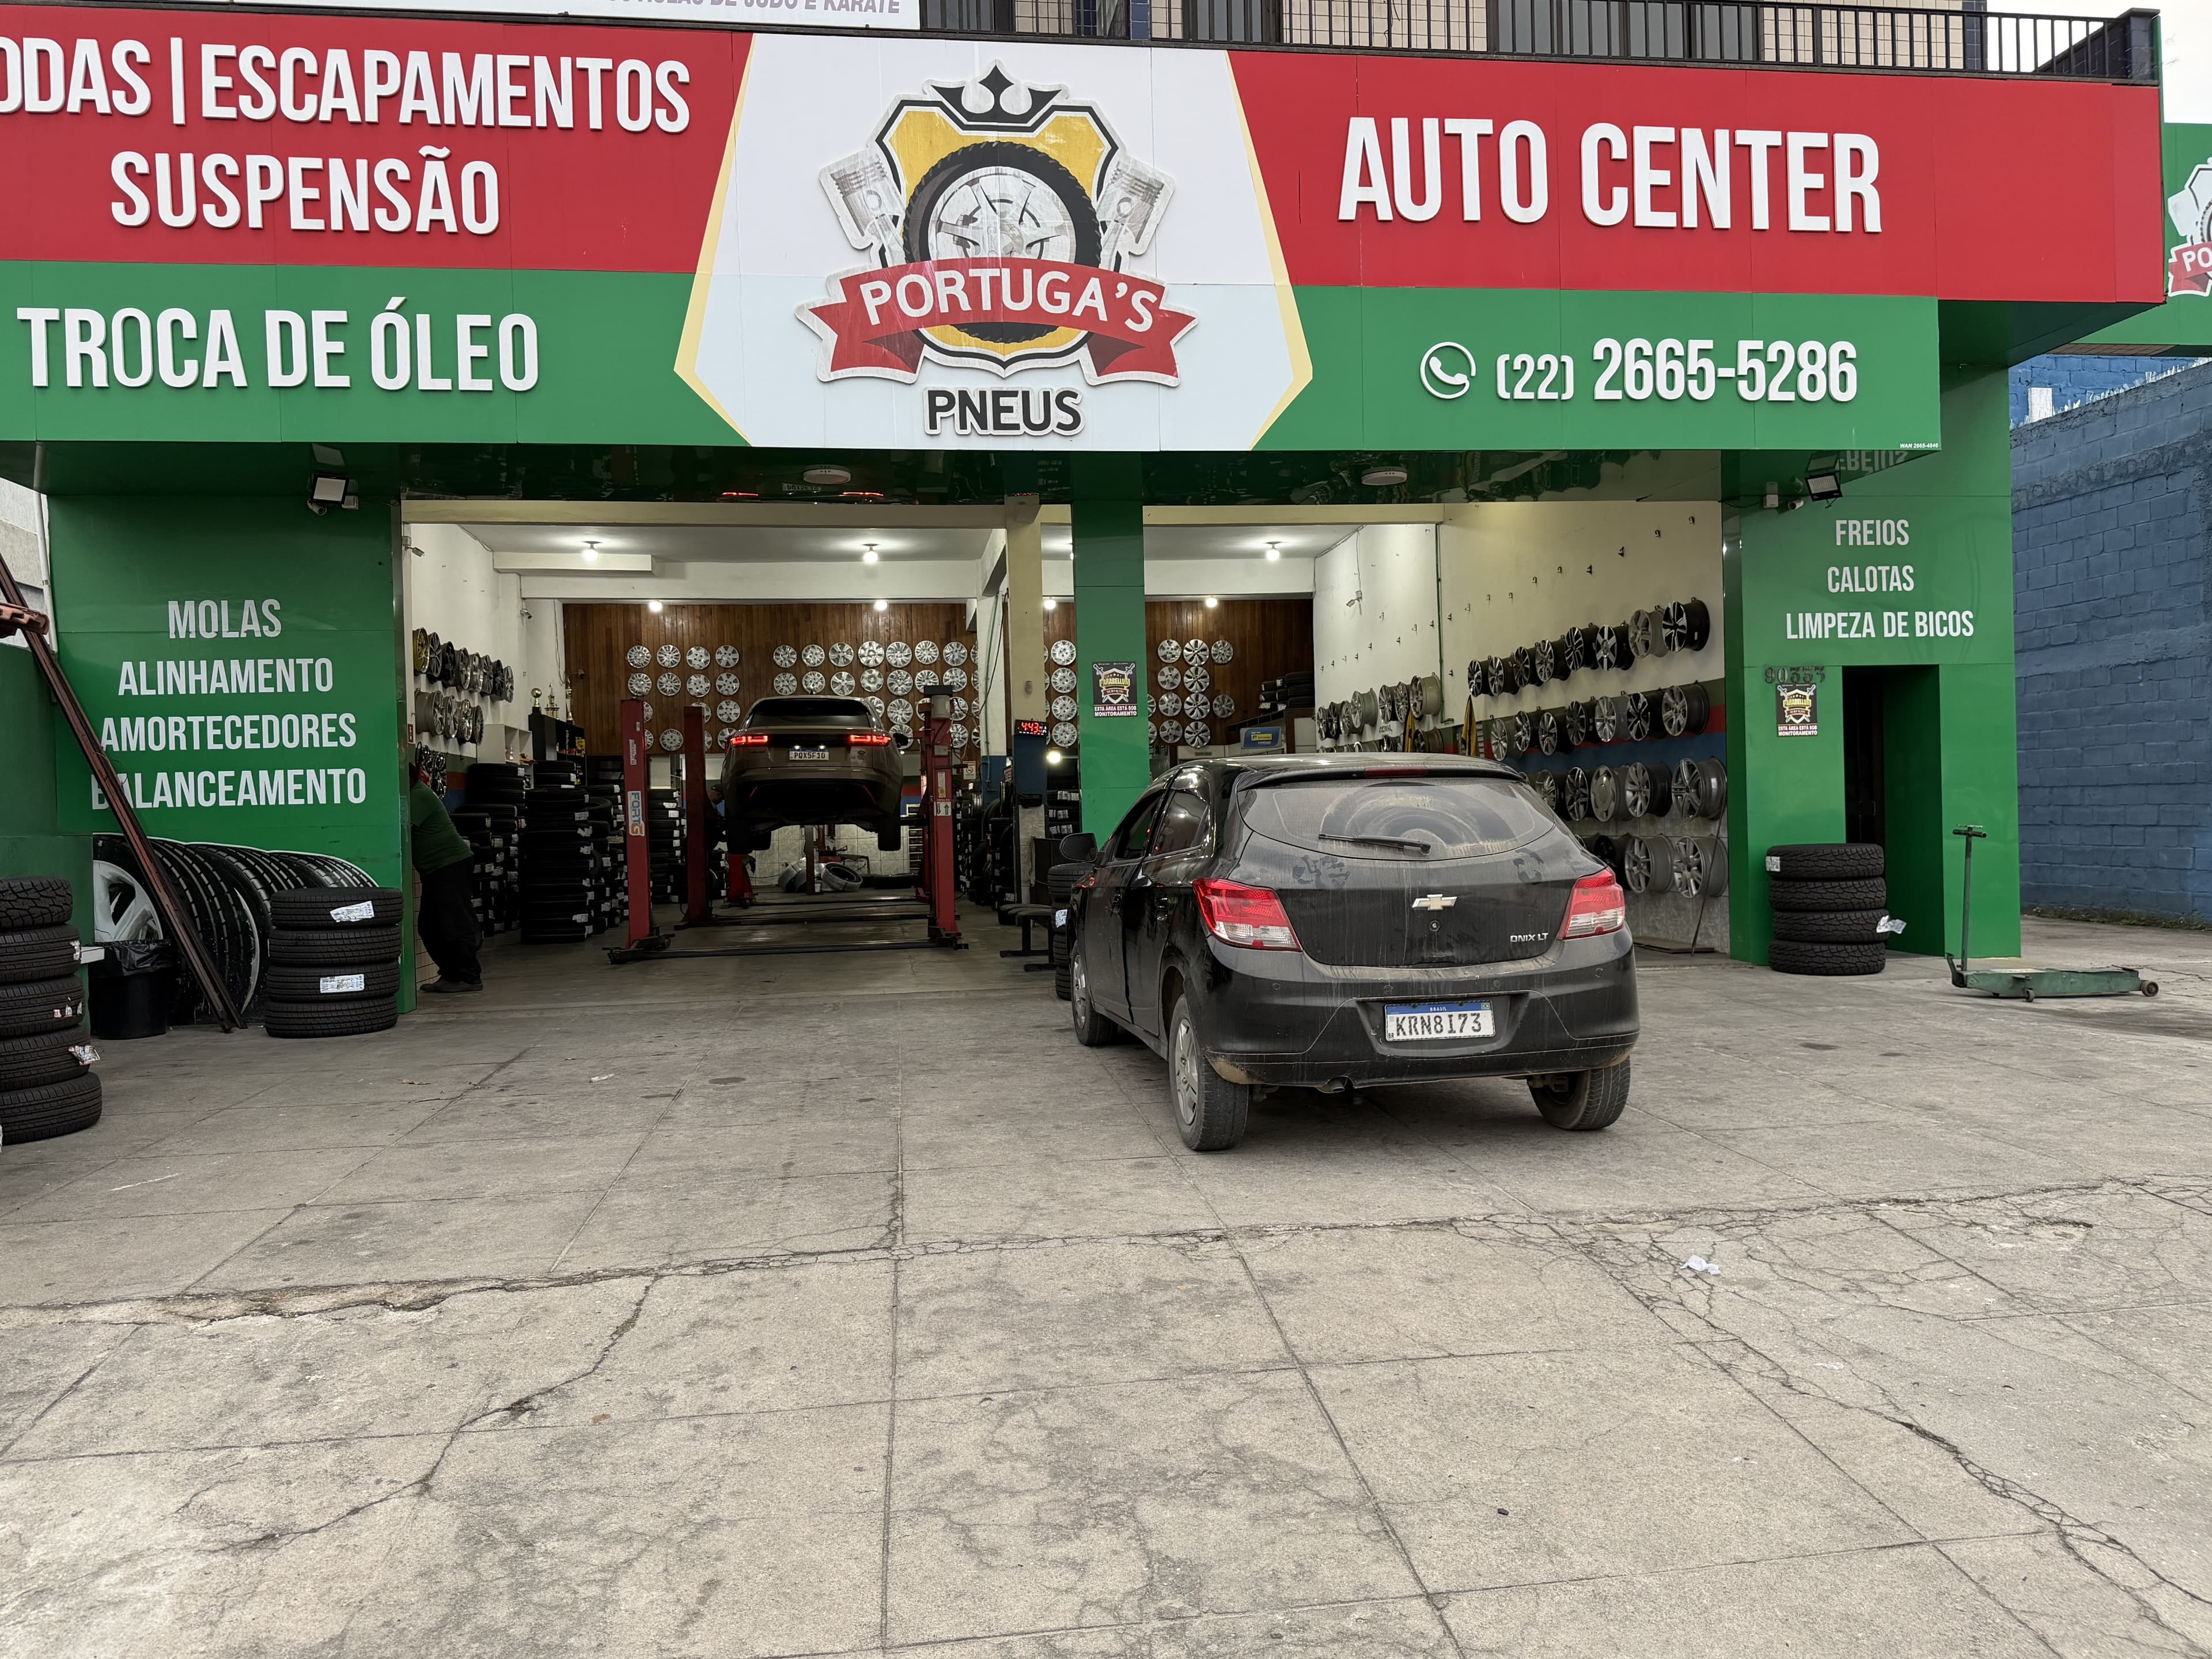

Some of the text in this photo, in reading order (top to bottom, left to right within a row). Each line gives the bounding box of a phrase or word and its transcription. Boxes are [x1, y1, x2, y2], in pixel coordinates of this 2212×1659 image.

[201, 43, 691, 134] ESCAPAMENTOS
[111, 145, 500, 236] SUSPENSÃO
[1338, 116, 1882, 234] AUTO CENTER
[860, 267, 1158, 333] PORTUGA'S
[17, 296, 539, 393] TROCA DE ÓLEO
[1496, 337, 1858, 403] (22) 2665-5286
[927, 389, 1081, 431] PNEUS
[1836, 520, 1909, 546] FREIOS
[1827, 565, 1914, 593] CALOTAS
[168, 599, 282, 639] MOLAS
[1786, 610, 1974, 639] LIMPEZA DE BICOS
[118, 658, 334, 696] ALINHAMENTO
[100, 713, 357, 752] AMORTECEDORES
[1510, 933, 1549, 942] ONIX LT
